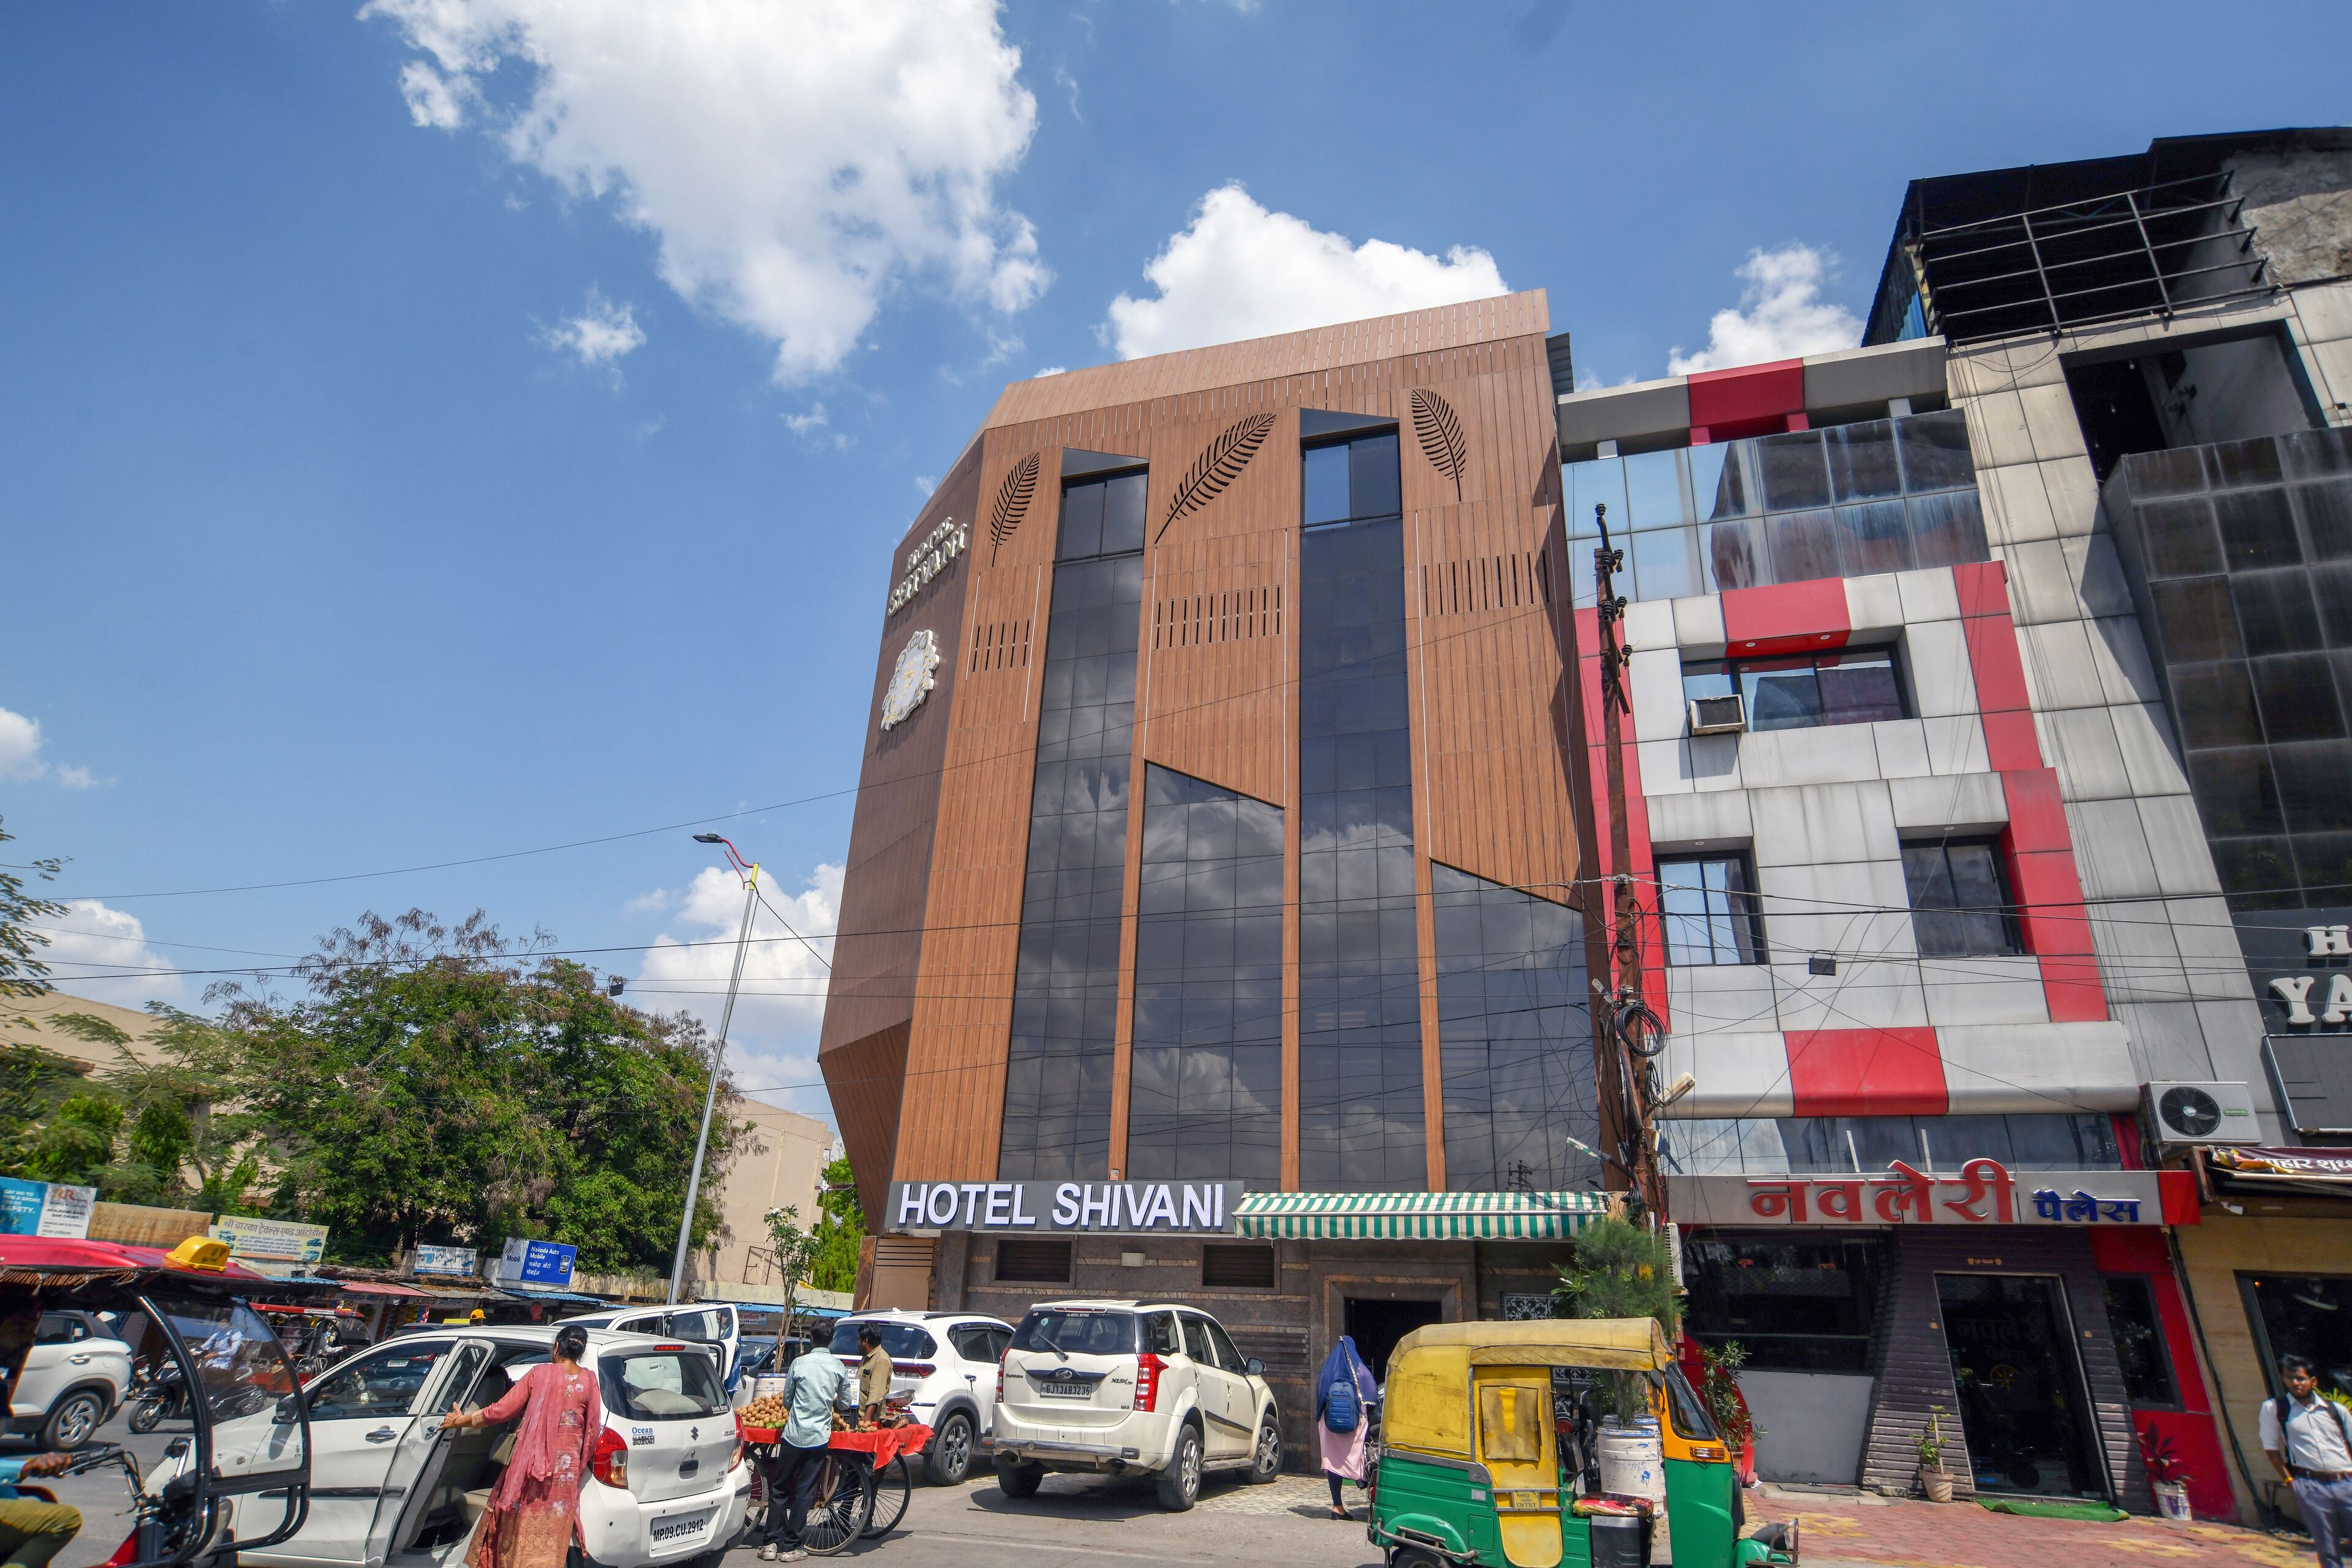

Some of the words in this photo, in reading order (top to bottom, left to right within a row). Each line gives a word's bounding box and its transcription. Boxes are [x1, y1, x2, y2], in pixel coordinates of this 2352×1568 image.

[888, 523, 967, 616] SHIVANI
[906, 516, 954, 573] HOTEL
[898, 1183, 1038, 1226] HOTEL
[1052, 1183, 1224, 1227] SHIVANI
[1747, 1158, 2015, 1223] नवलेरी
[2031, 1188, 2141, 1222] पैलेस
[224, 1219, 234, 1229] श्री
[1046, 1384, 1090, 1395] GJ13AB3235
